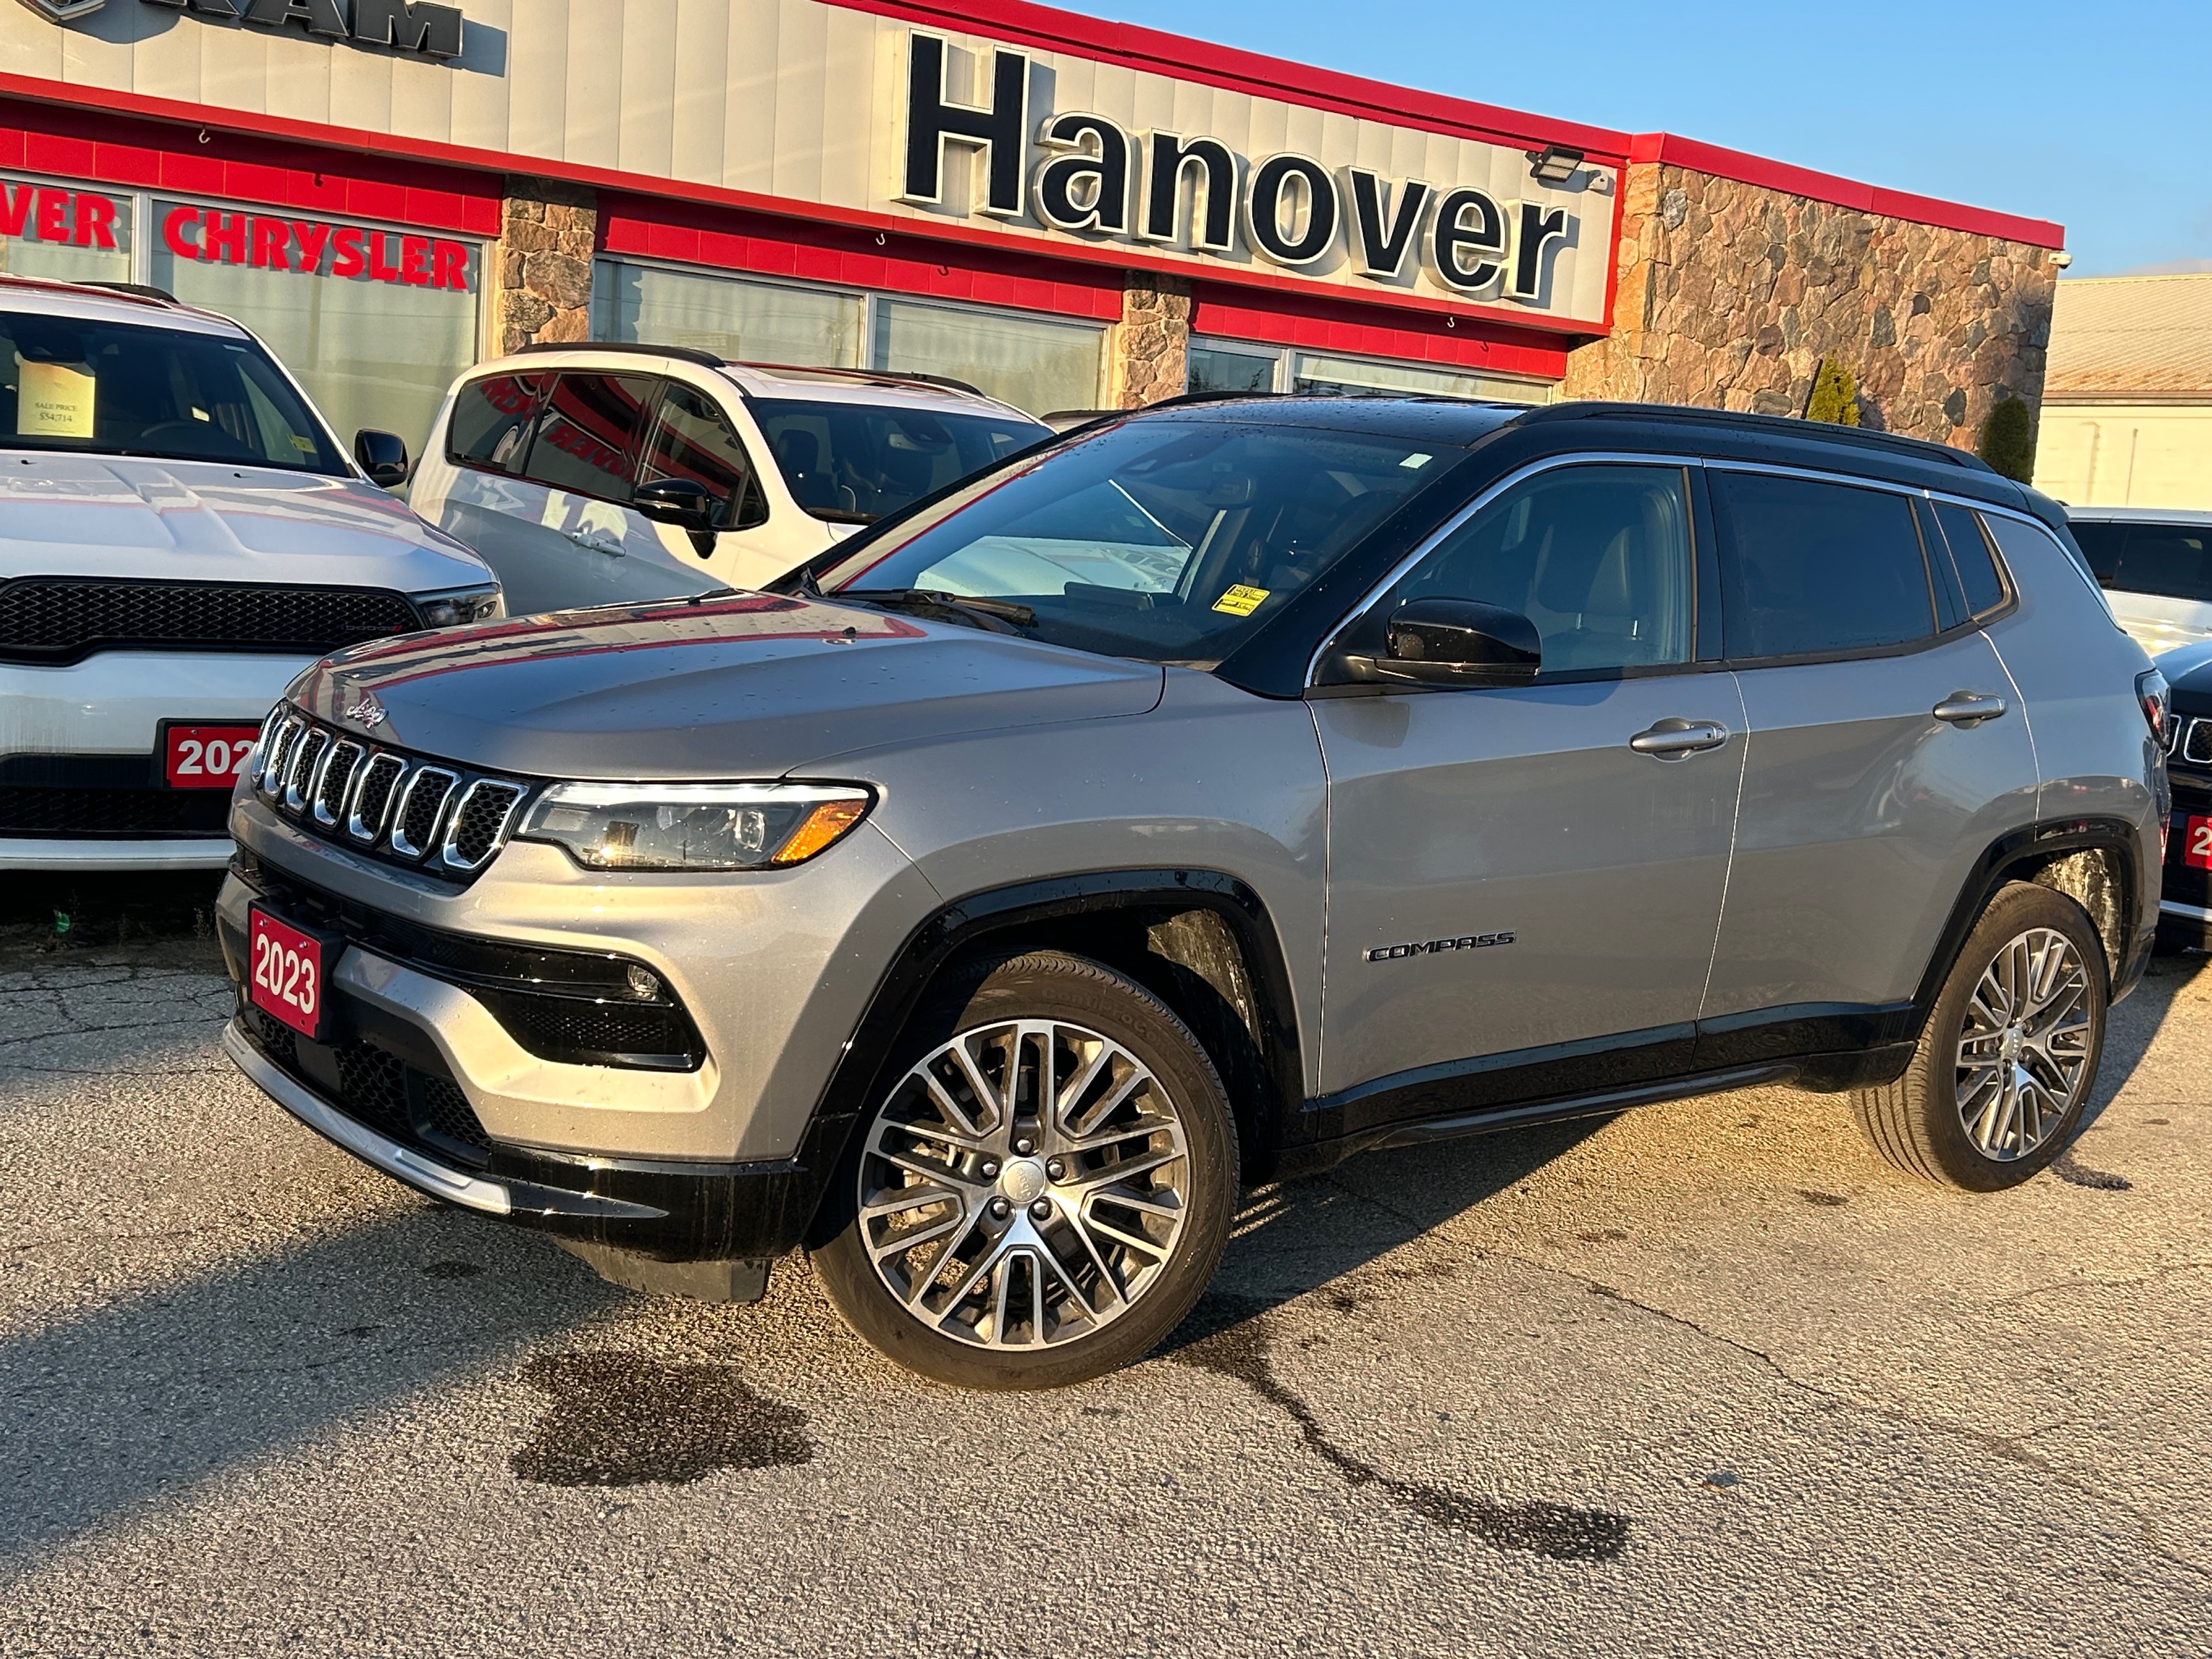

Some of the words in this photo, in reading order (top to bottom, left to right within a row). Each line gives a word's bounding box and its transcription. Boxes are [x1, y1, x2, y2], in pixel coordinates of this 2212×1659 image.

[139, 0, 463, 57] AM
[900, 27, 1569, 300] Hanover
[163, 207, 469, 290] CHRYSLER
[346, 698, 387, 729] Jeep
[256, 933, 315, 1015] 2023
[1364, 930, 1516, 962] COMPASS
